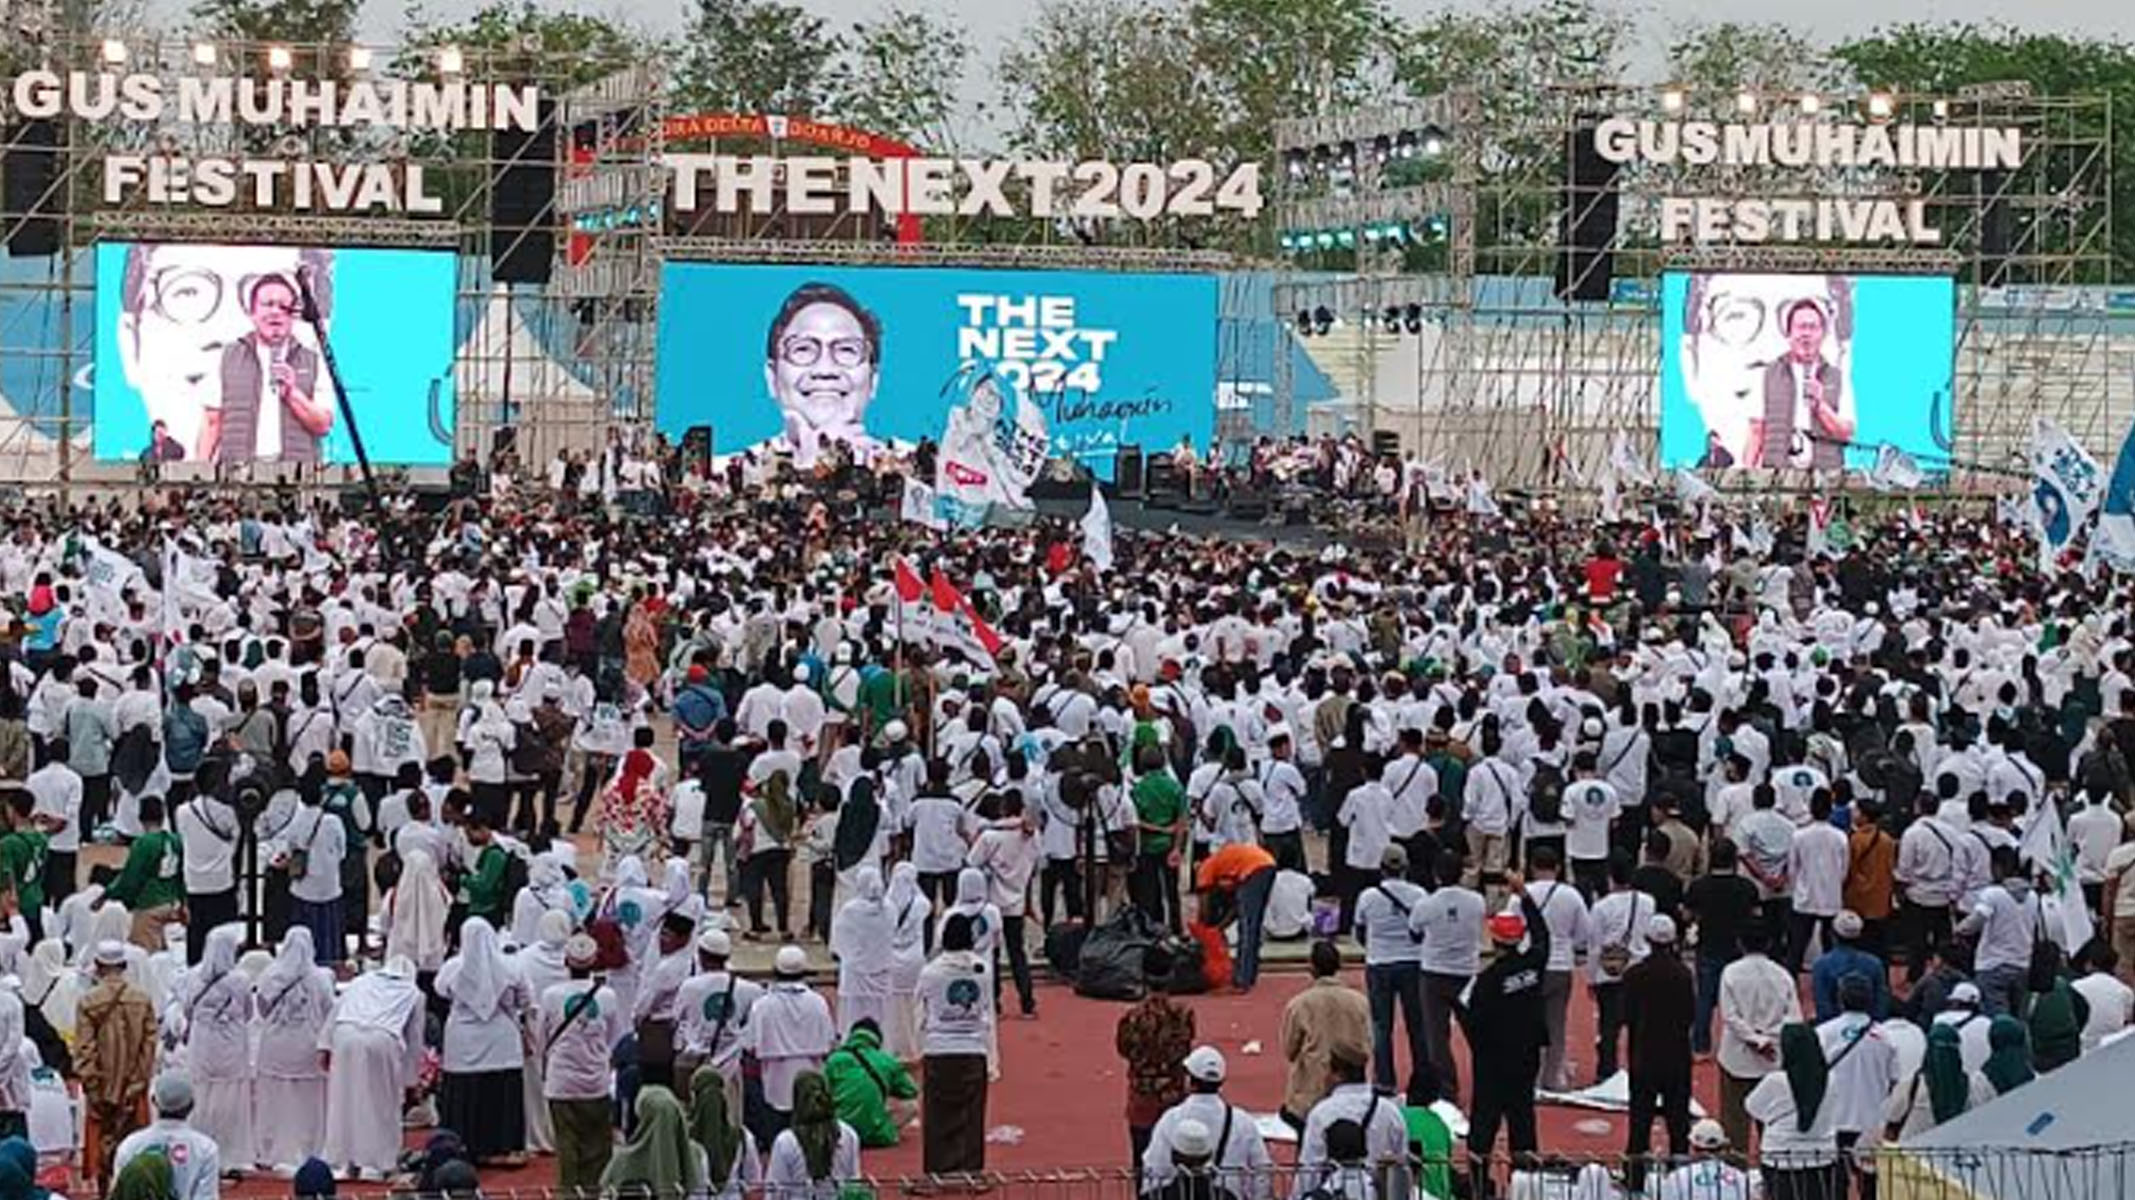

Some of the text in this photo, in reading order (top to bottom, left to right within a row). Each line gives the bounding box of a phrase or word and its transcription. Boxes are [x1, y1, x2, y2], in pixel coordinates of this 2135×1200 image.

[13, 69, 538, 132] GUS MUHAIMIN
[1594, 119, 2022, 169] GUS MUHAIMIN
[104, 154, 442, 213] FESTIVAL
[1661, 197, 1941, 242] FESTIVAL
[957, 294, 1075, 326] THE
[958, 328, 1118, 361] NEXT
